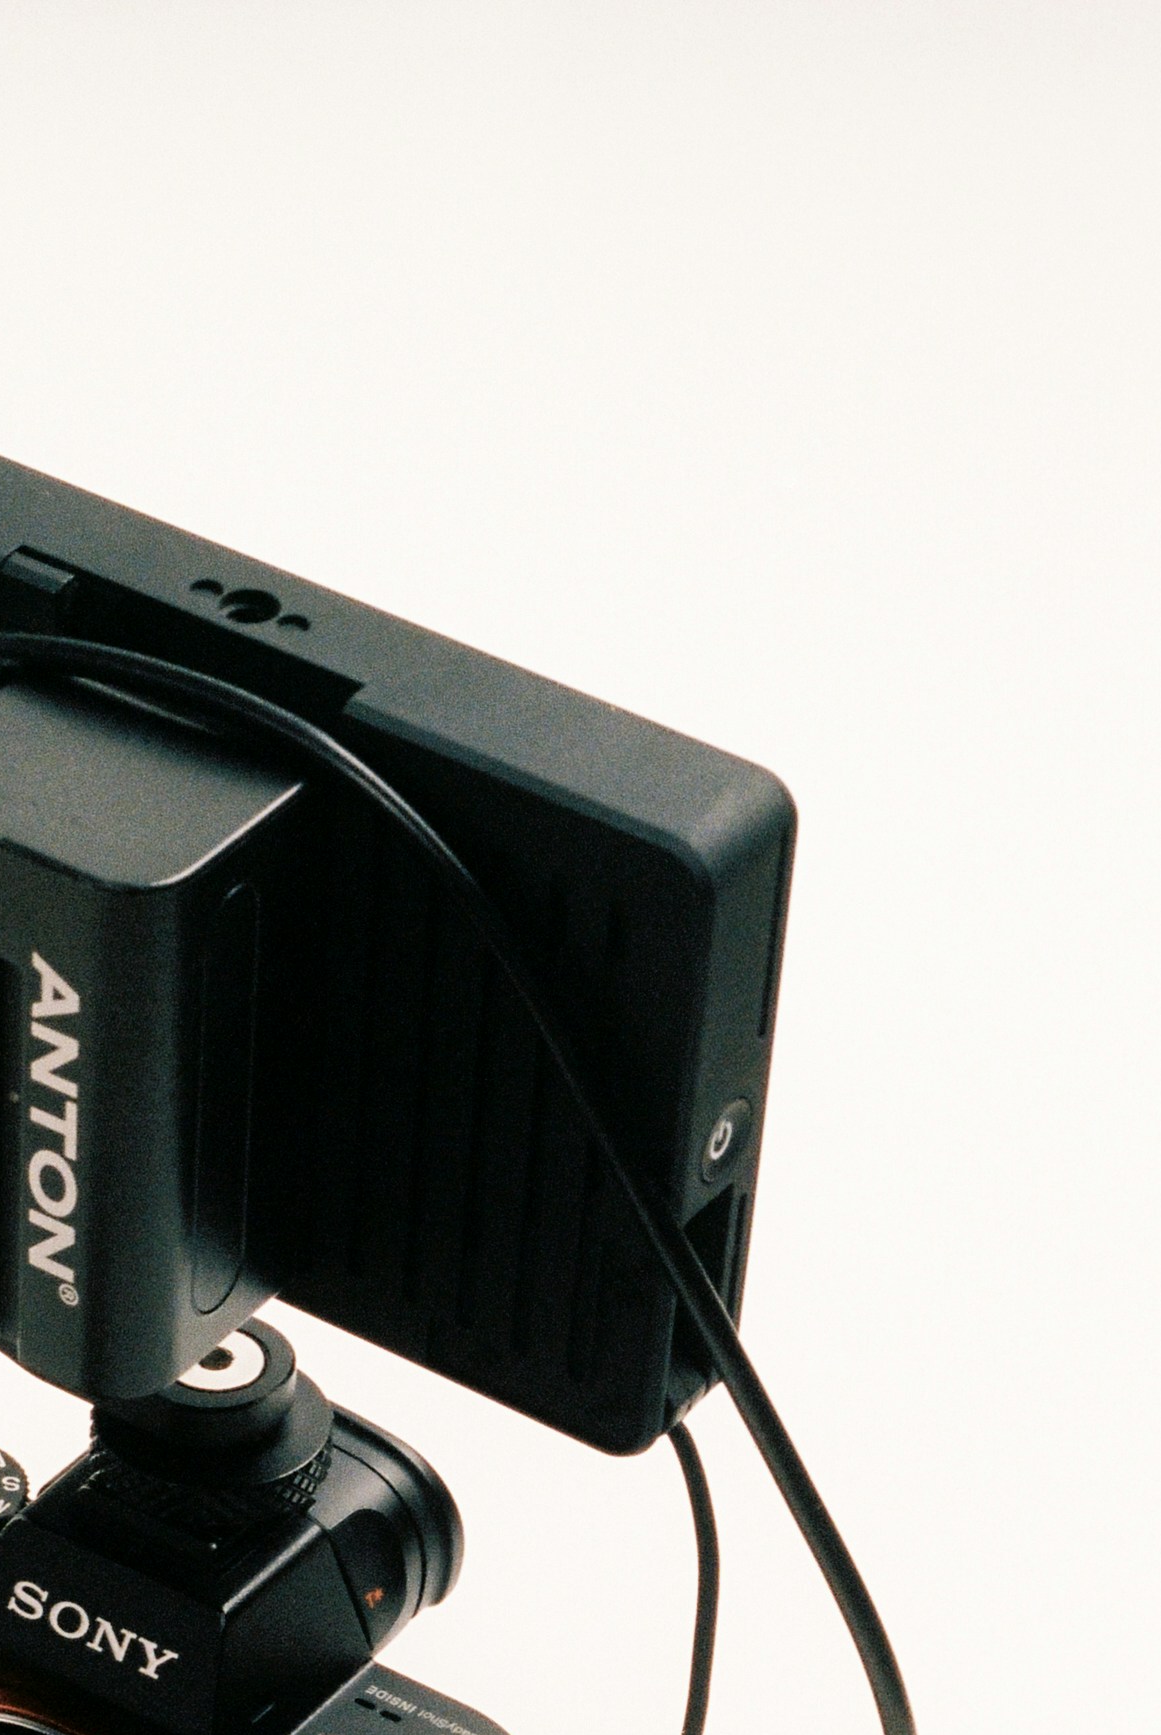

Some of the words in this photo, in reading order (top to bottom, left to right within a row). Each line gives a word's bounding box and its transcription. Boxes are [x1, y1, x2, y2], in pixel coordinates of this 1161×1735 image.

[1, 1476, 21, 1491] S
[6, 1580, 179, 1680] SONY
[364, 1684, 418, 1714] INSIDE
